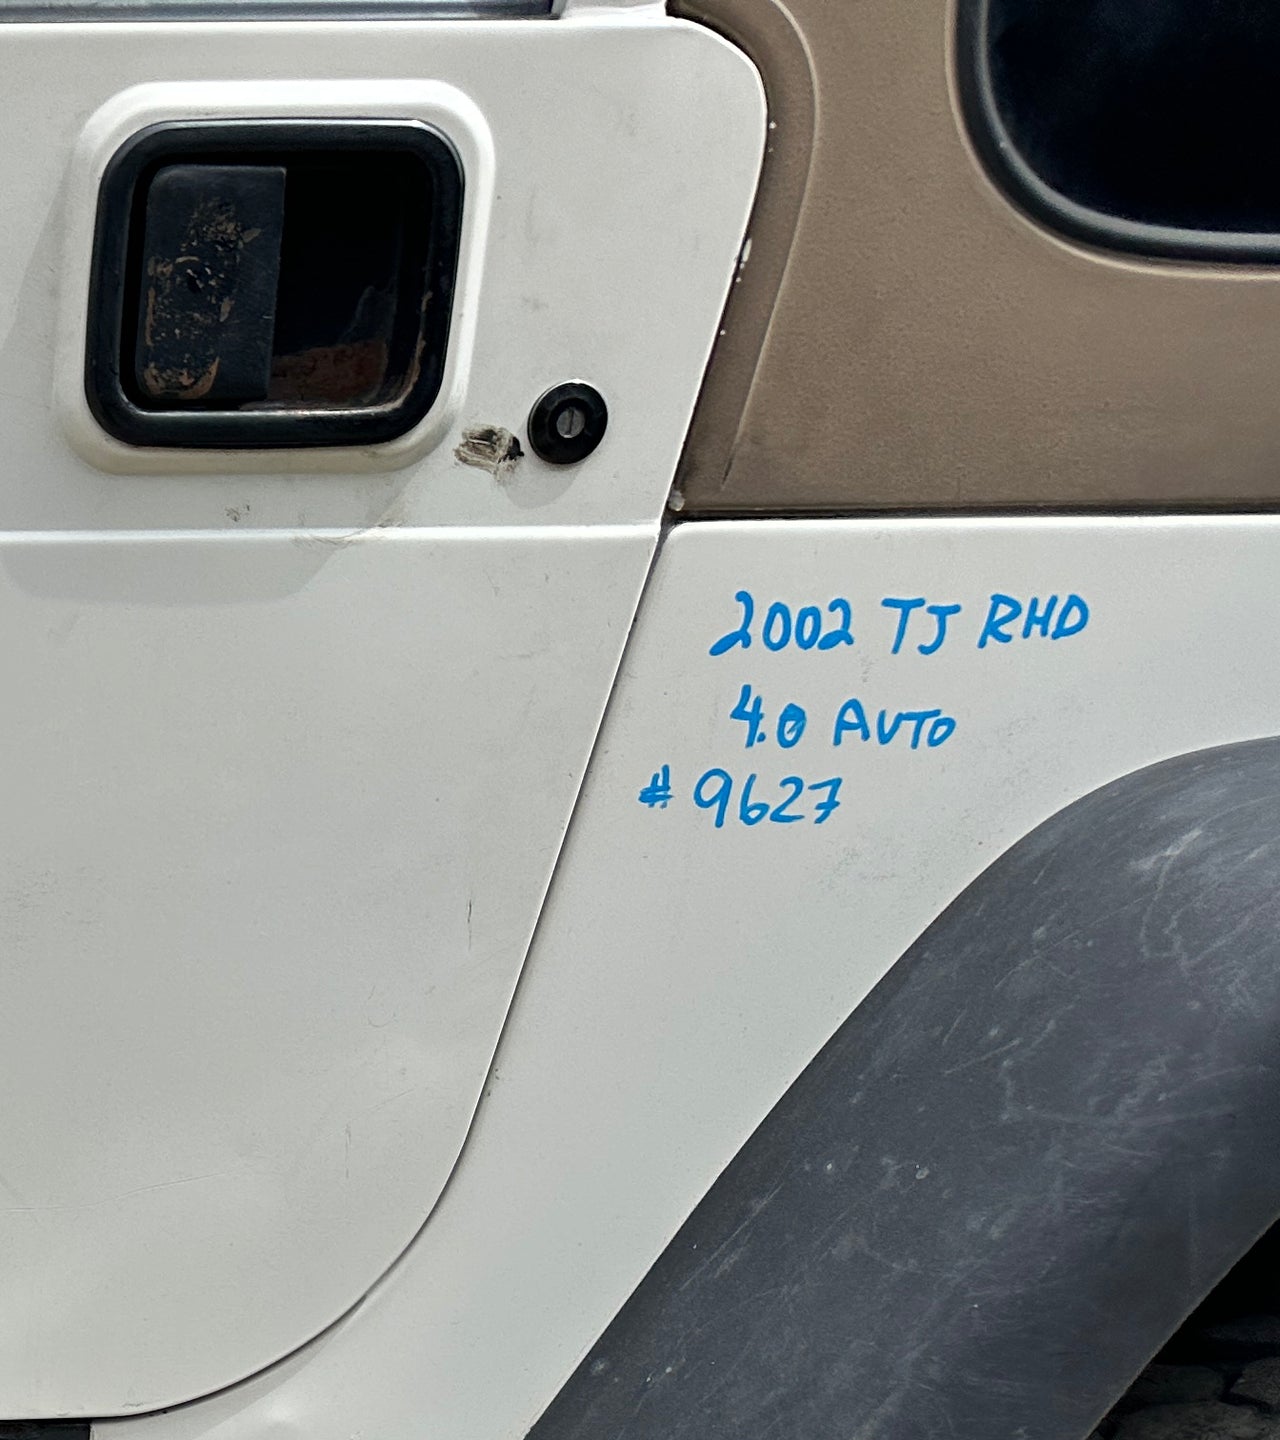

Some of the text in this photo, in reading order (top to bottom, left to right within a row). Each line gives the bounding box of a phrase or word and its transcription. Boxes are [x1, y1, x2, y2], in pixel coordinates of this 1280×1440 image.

[709, 590, 1090, 656] 2002 TJ RHD
[730, 684, 957, 749] 4.0 AUTO
